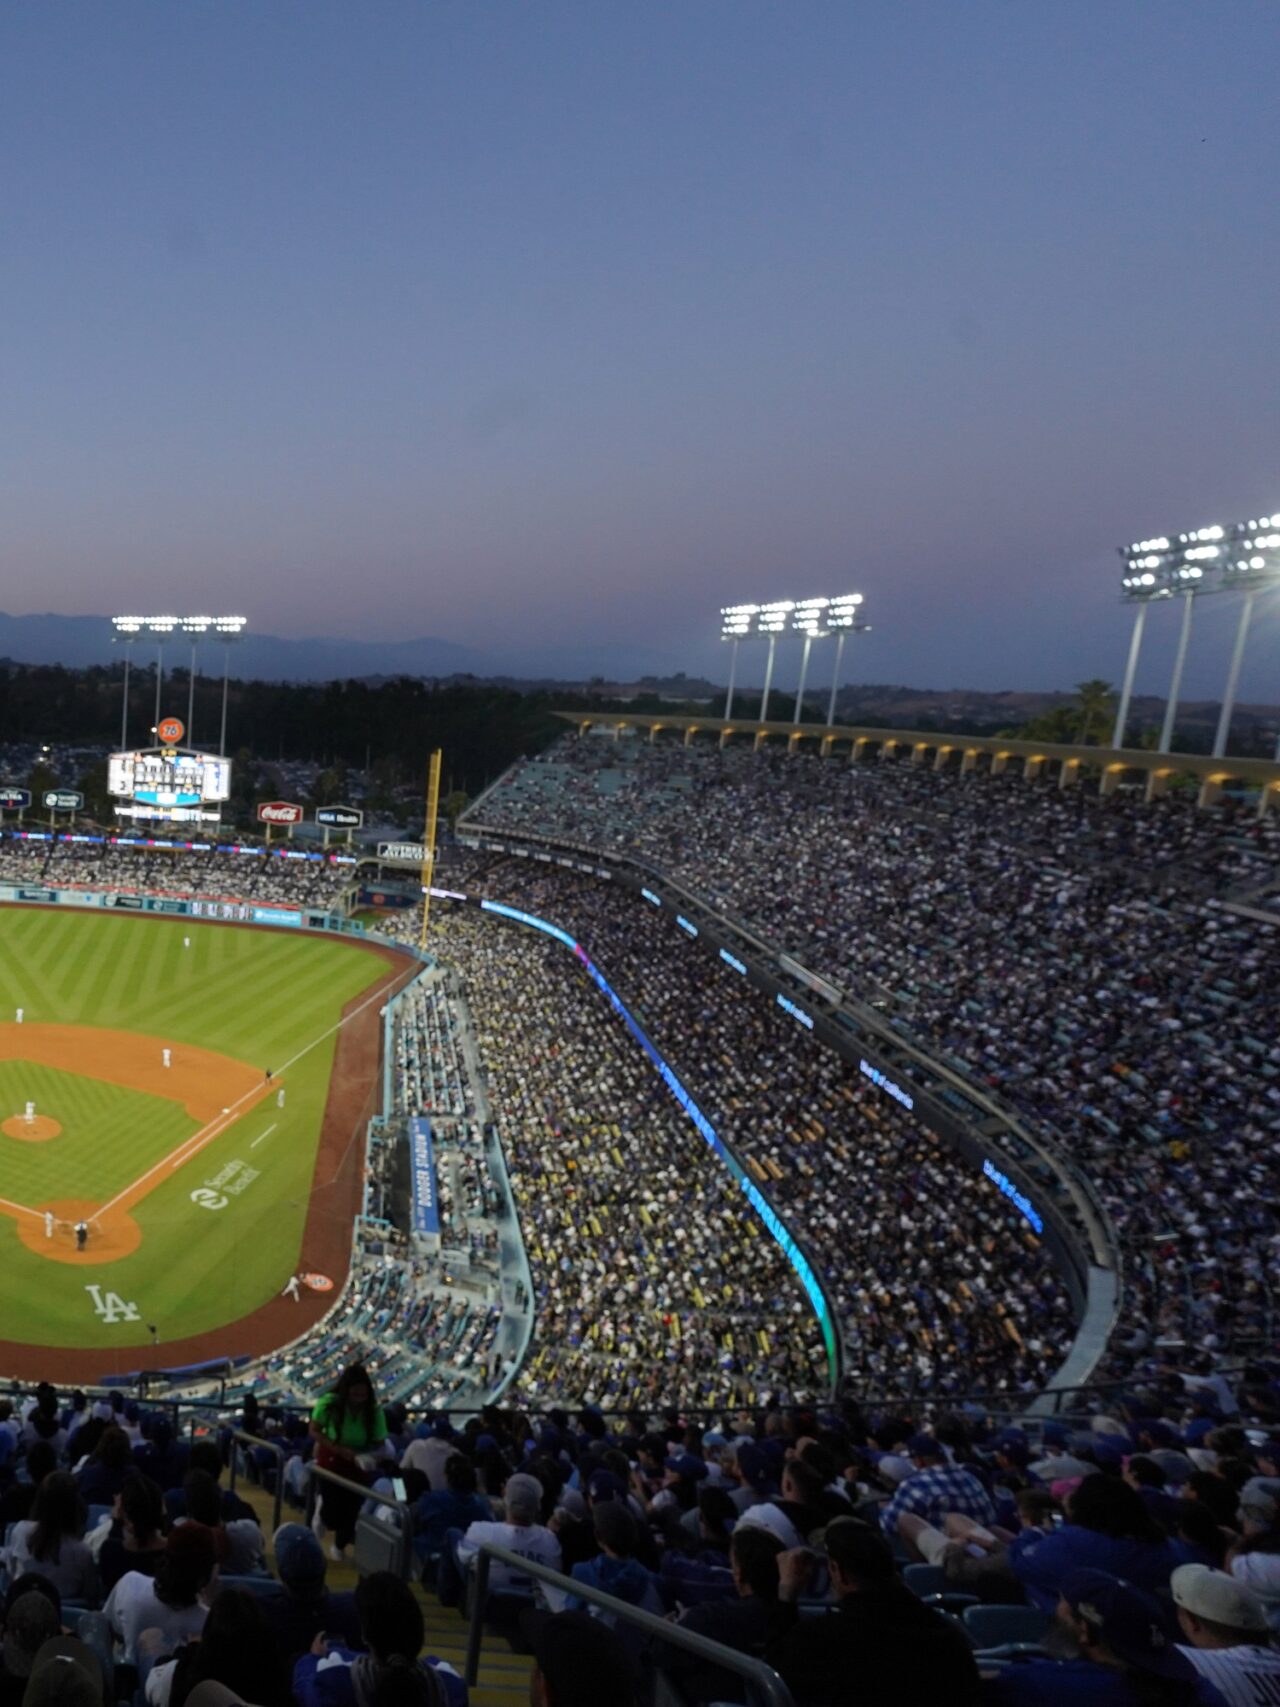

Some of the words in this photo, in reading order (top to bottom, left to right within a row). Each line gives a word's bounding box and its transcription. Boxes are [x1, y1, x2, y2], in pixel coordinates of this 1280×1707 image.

[165, 726, 177, 736] 76
[415, 1134, 429, 1169] STADIUM
[204, 1159, 248, 1190] Security
[417, 1170, 432, 1207] DODGER
[85, 1284, 141, 1323] LA
